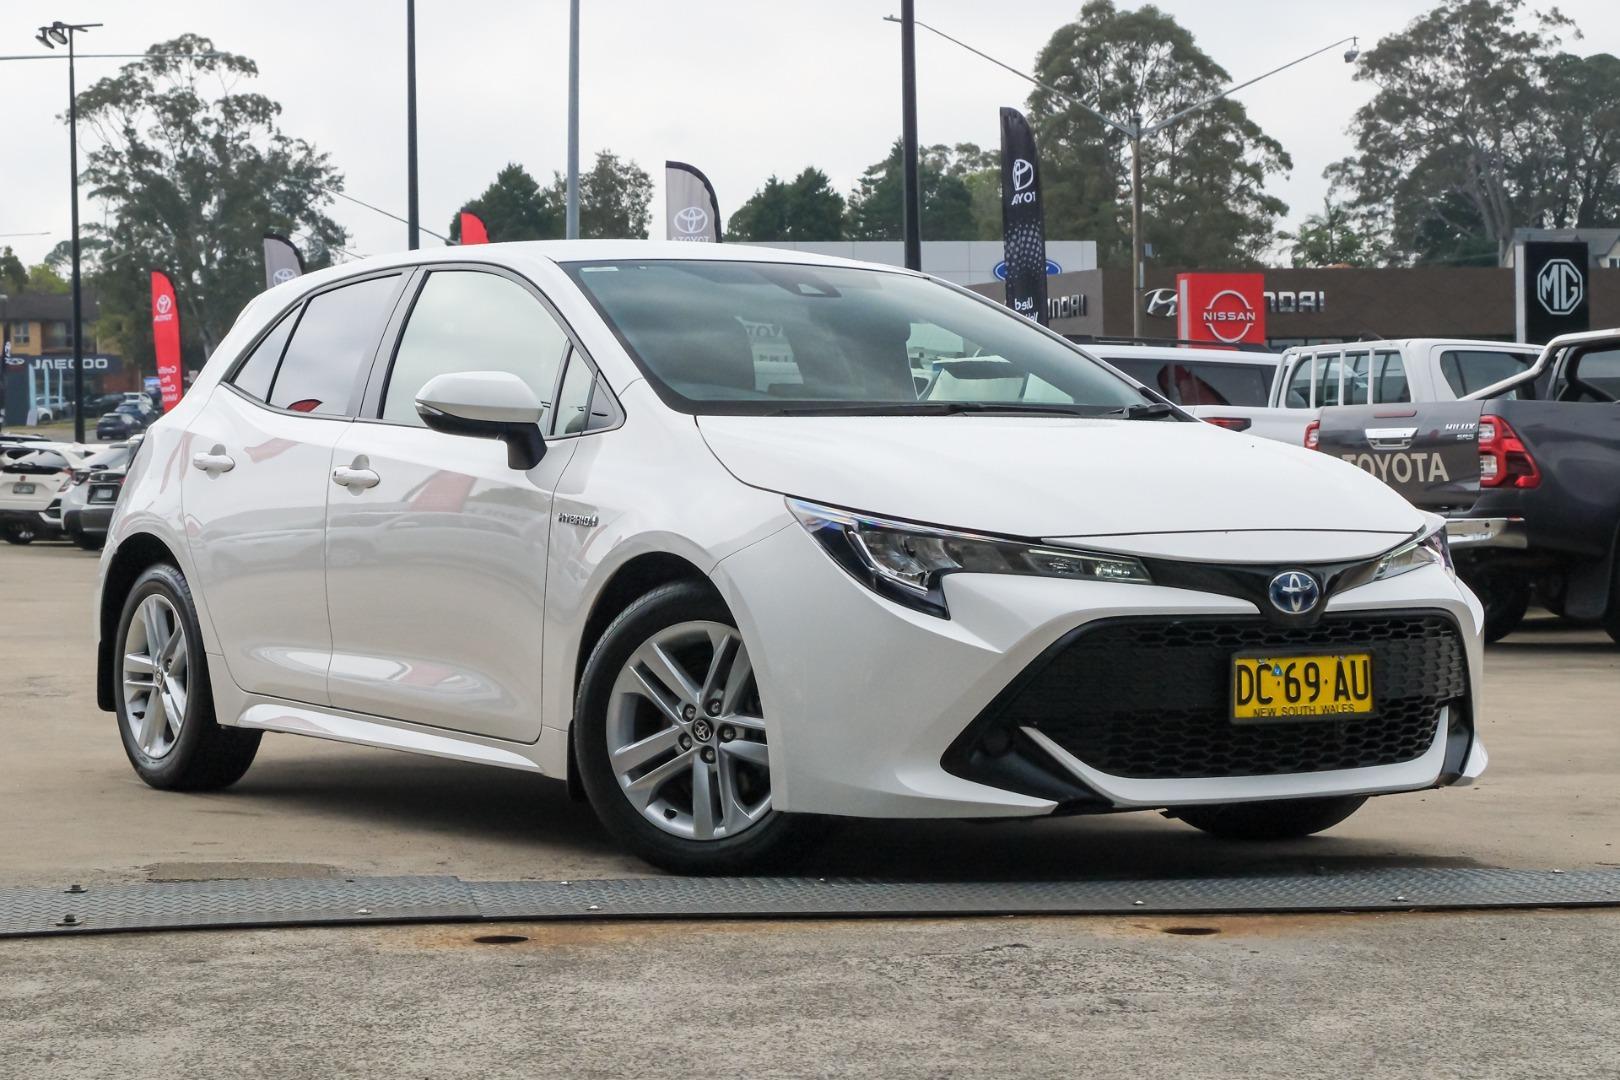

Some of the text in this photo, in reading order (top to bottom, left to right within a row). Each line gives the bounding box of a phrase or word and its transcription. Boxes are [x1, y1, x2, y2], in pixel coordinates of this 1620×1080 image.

[1541, 264, 1579, 310] MG
[1203, 311, 1256, 321] NISSAN
[1253, 703, 1355, 717] NEW SOUTH WALES
